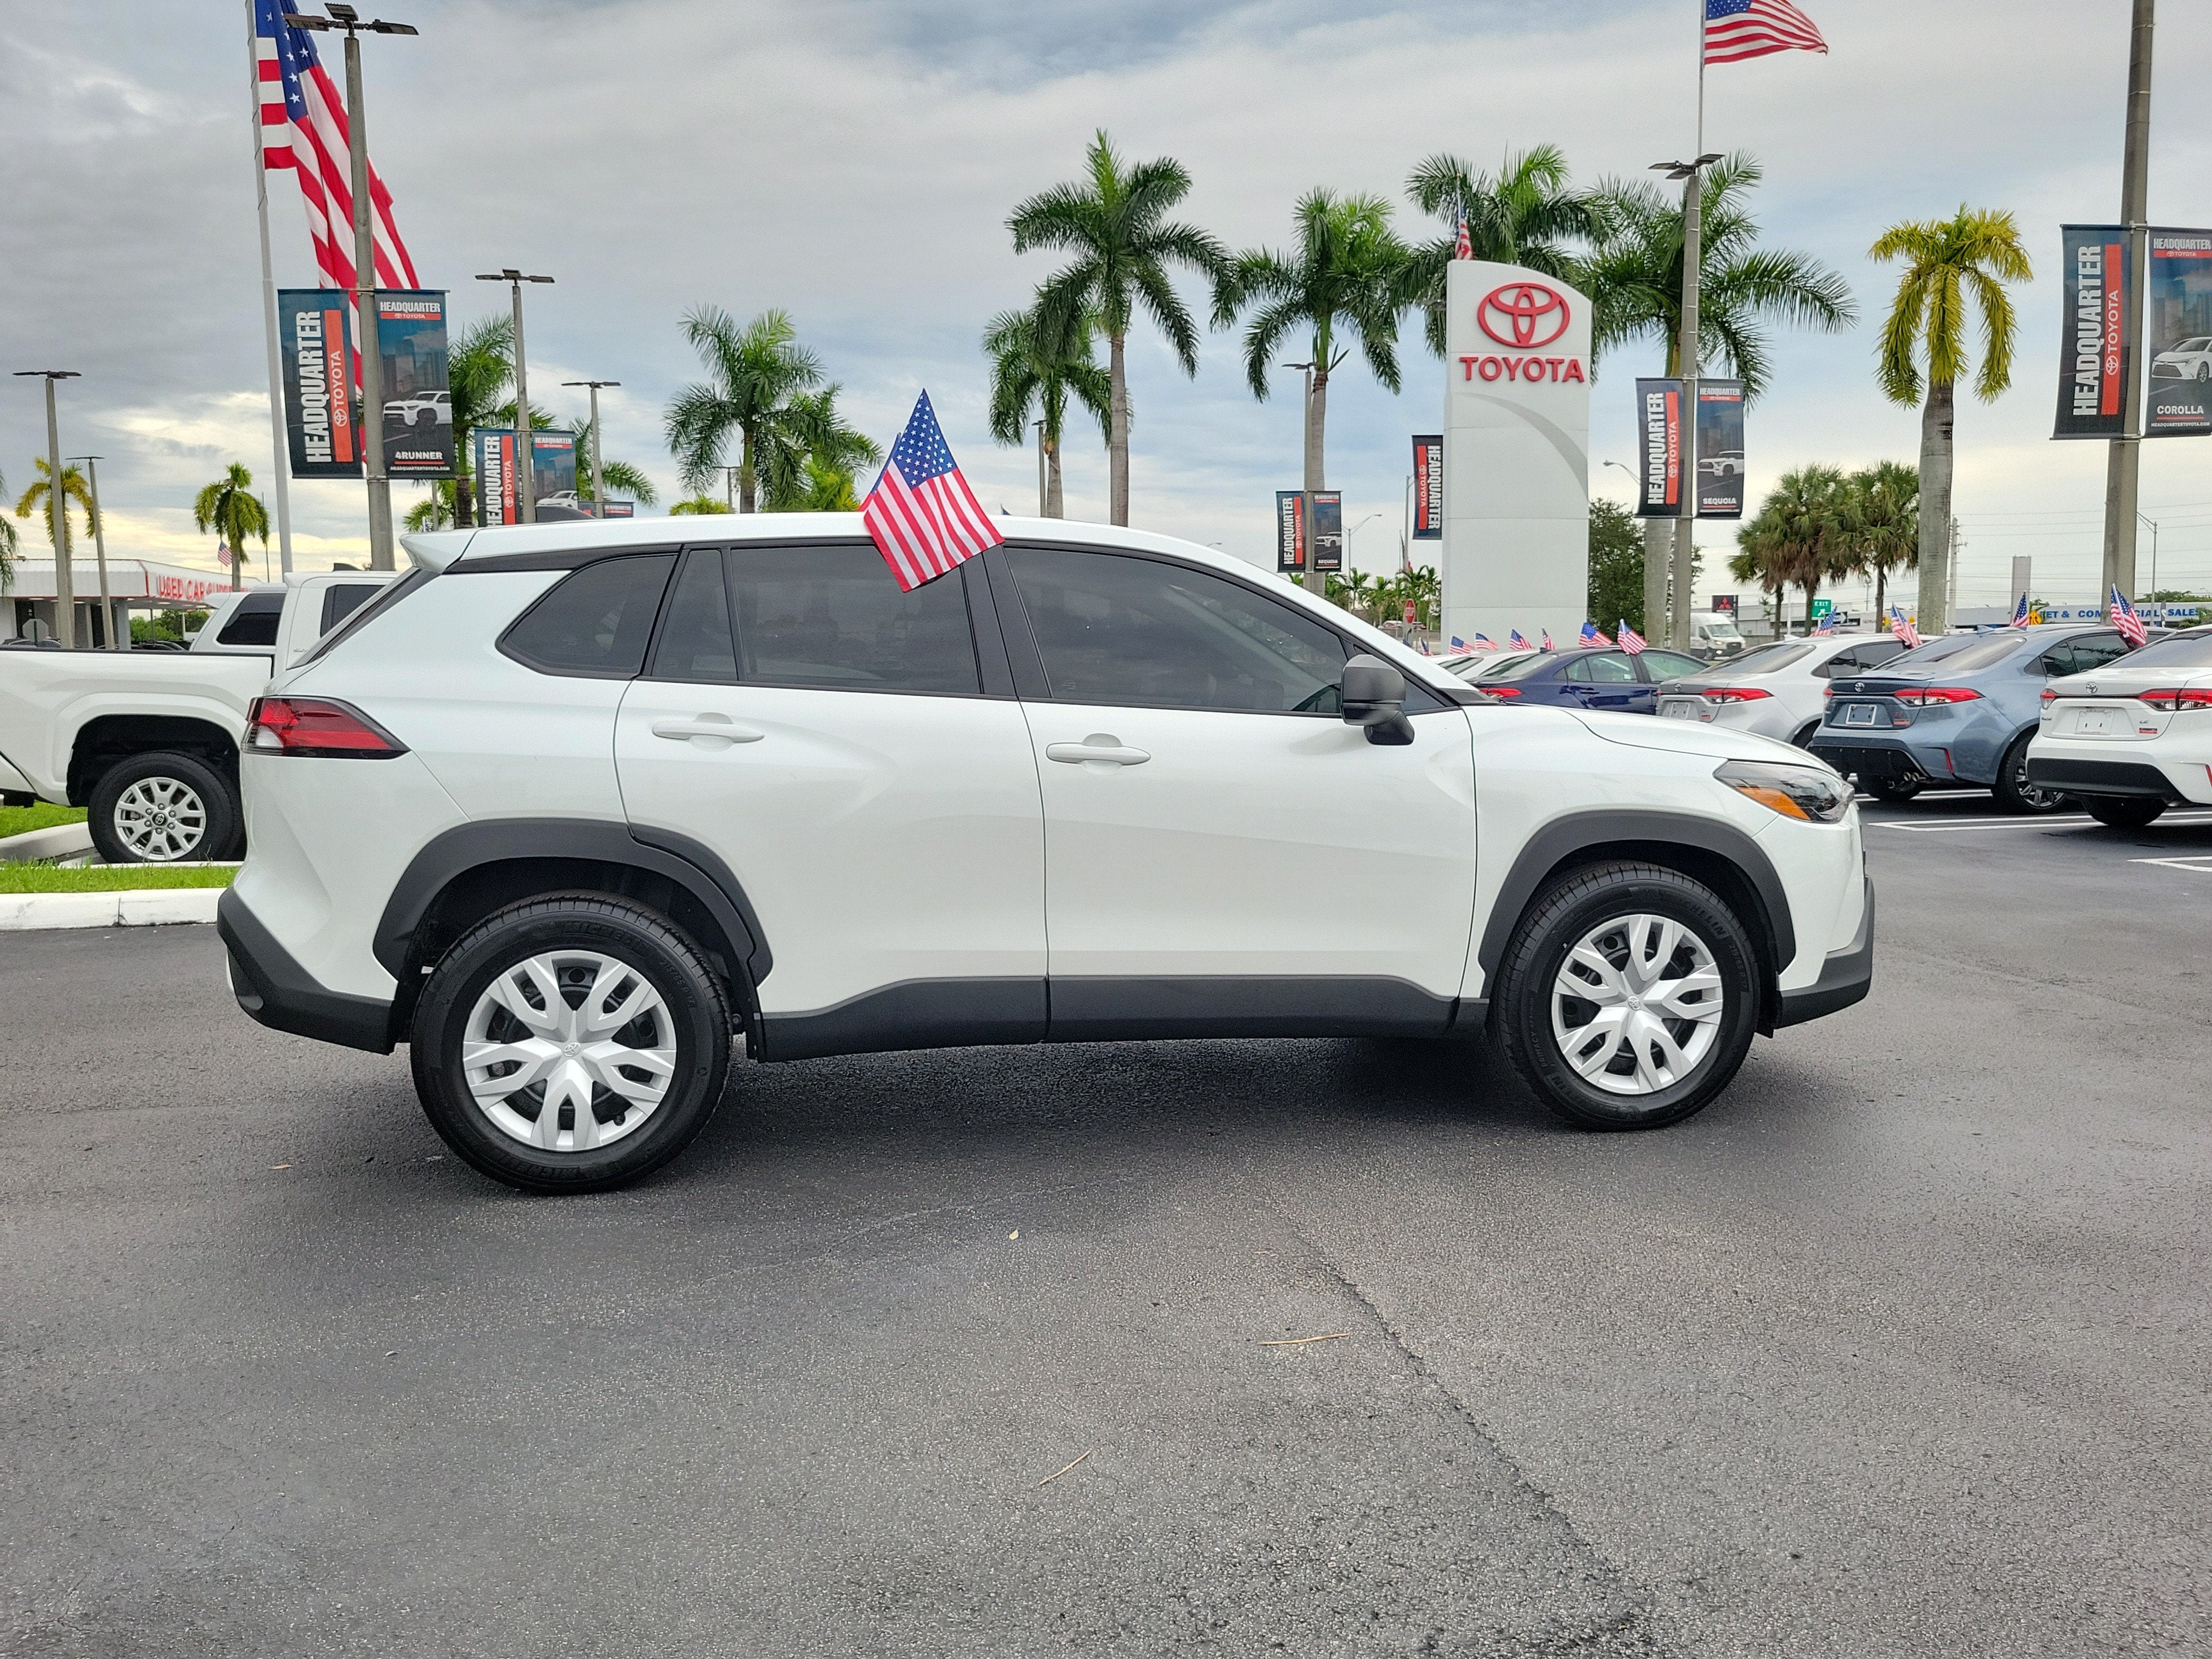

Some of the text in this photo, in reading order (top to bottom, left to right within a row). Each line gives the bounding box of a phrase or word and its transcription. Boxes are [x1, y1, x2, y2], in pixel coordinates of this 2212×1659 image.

[2153, 238, 2211, 251] HEADQUARTER
[380, 302, 441, 313] HEADQUARTER
[2107, 290, 2119, 354] TOYOTA
[2073, 245, 2104, 416] HEADQUARTER
[296, 311, 332, 463] HEADQUARTER
[331, 350, 345, 408] TOYOTA
[1459, 356, 1585, 383] TOYOTA
[2157, 405, 2204, 415] COROLLA
[395, 451, 443, 460] 4RUNNER
[1646, 392, 1667, 505] HEADQUARTER
[1668, 421, 1678, 464] TOYOTA
[484, 436, 503, 527] HEADQUARTER
[504, 460, 512, 496] TOYOTA
[1427, 445, 1441, 529] HEADQUARTER
[1702, 497, 1737, 505] SEQUOIA
[1282, 497, 1295, 565] HEADQUARTER
[157, 575, 184, 599] USED
[186, 579, 205, 600] CAR
[2061, 610, 2070, 618] &
